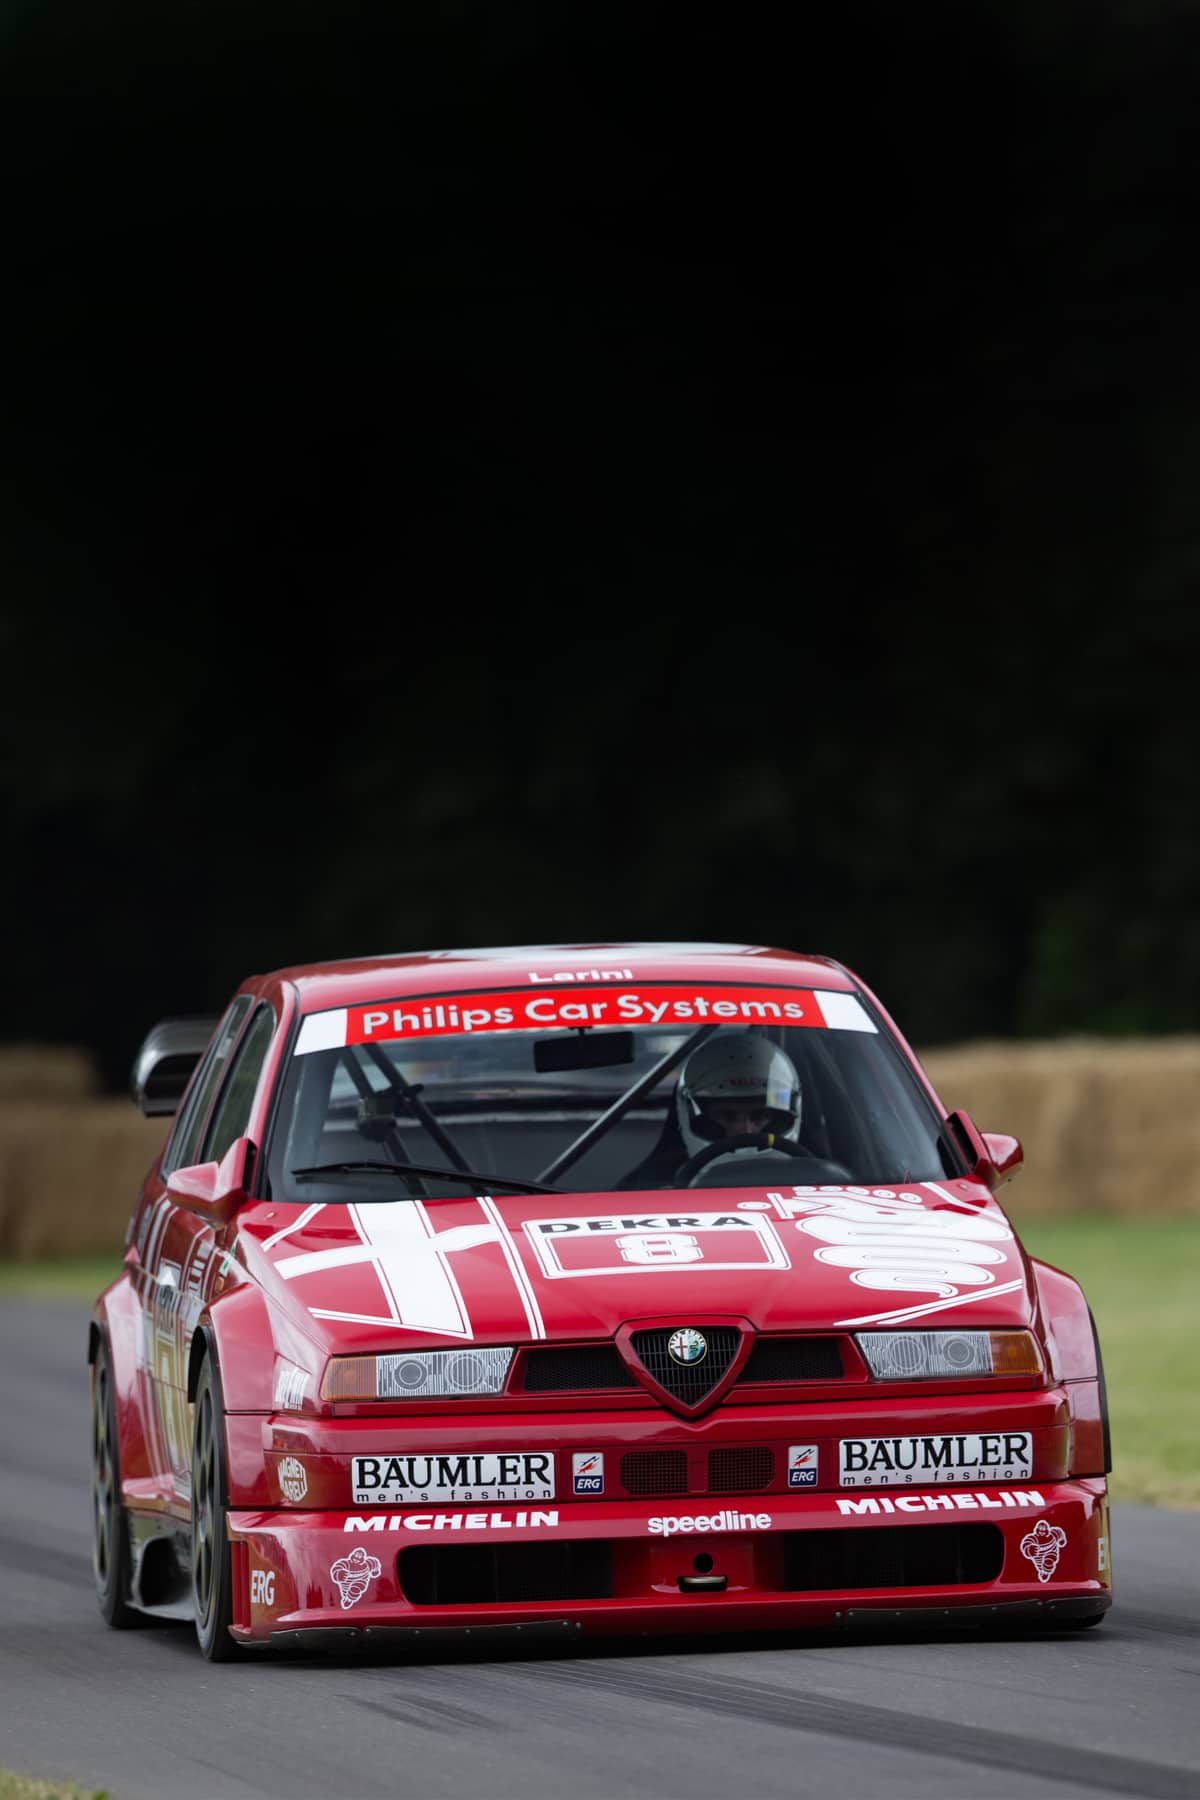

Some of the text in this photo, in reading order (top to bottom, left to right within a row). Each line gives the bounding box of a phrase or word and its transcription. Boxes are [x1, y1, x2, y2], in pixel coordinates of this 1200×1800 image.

[362, 994, 804, 1036] Philips Car Systems
[538, 1214, 754, 1234] DEKRA
[614, 1233, 705, 1264] 8
[843, 1433, 1029, 1472] BÄUMLER
[356, 1453, 552, 1490] BÄUMLER
[576, 1477, 601, 1490] ERG
[790, 1471, 815, 1483] ERG
[842, 1467, 1029, 1486] men's fashion
[357, 1487, 552, 1503] men's fashion
[836, 1490, 1046, 1516] MICHELIN
[344, 1511, 559, 1533] MICHELIN
[647, 1511, 772, 1537] speedline
[250, 1570, 276, 1606] ERG
